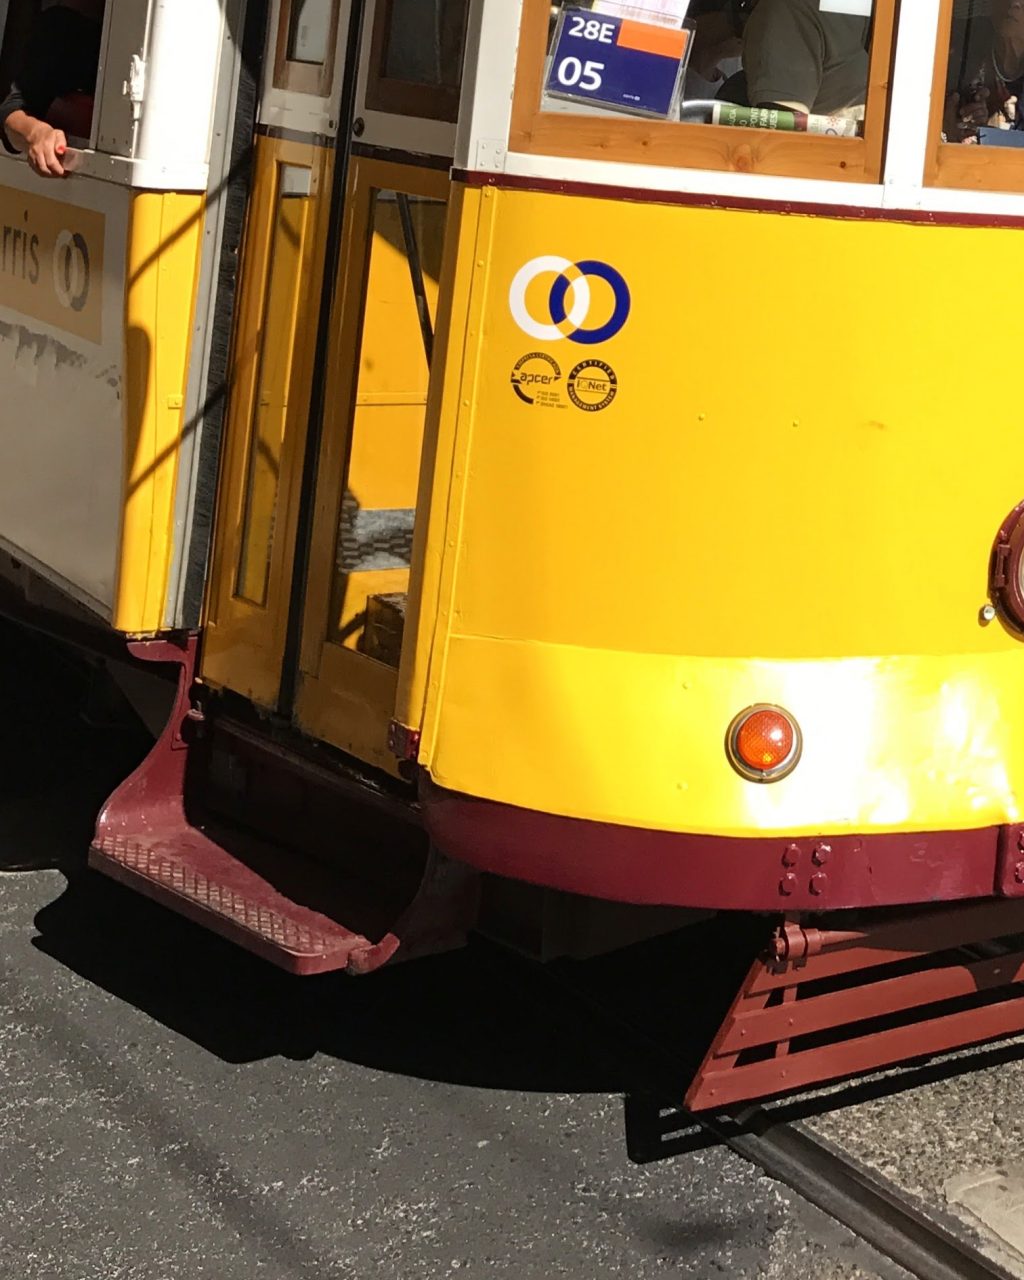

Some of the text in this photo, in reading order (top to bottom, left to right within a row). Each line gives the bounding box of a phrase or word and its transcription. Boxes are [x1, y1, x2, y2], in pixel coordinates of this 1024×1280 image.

[568, 17, 615, 44] 28E
[557, 56, 604, 91] 05
[520, 372, 553, 385] apcer
